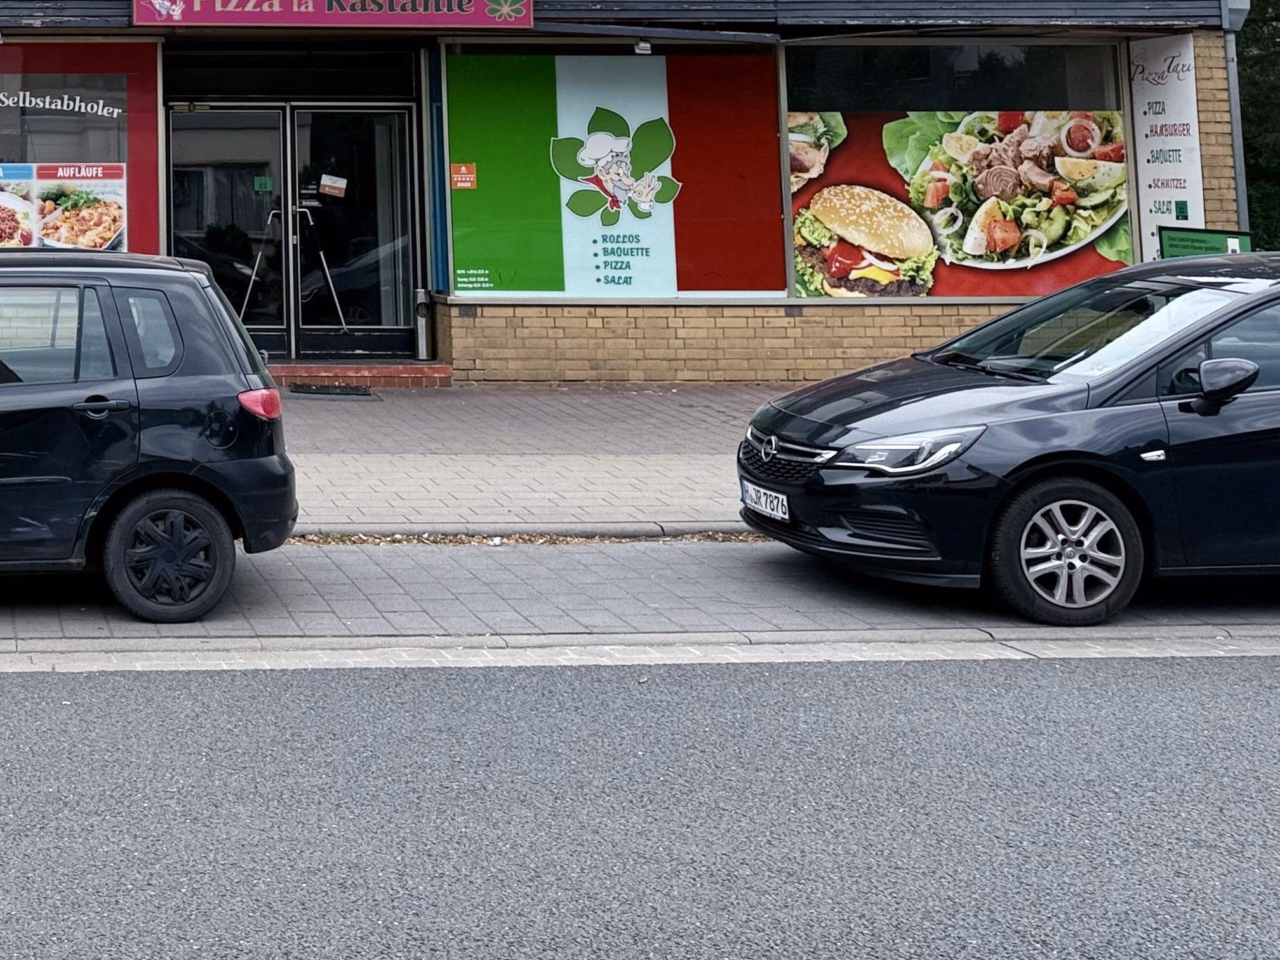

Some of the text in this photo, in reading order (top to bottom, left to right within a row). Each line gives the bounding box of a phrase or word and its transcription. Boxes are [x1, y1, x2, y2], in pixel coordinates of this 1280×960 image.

[1130, 52, 1193, 86] Pizza Taxi
[0, 91, 122, 119] Selbstabholer
[1147, 101, 1166, 115] PIZZA
[1150, 123, 1192, 137] HAMBURGER
[57, 164, 104, 178] AUFLÄUFE
[1152, 178, 1187, 189] SCHNITZEL
[1154, 200, 1172, 214] SALAT
[601, 234, 641, 244] ROLLOS
[603, 260, 631, 270] PIZZA
[603, 275, 633, 286] SALAT
[763, 491, 787, 516] 7876
